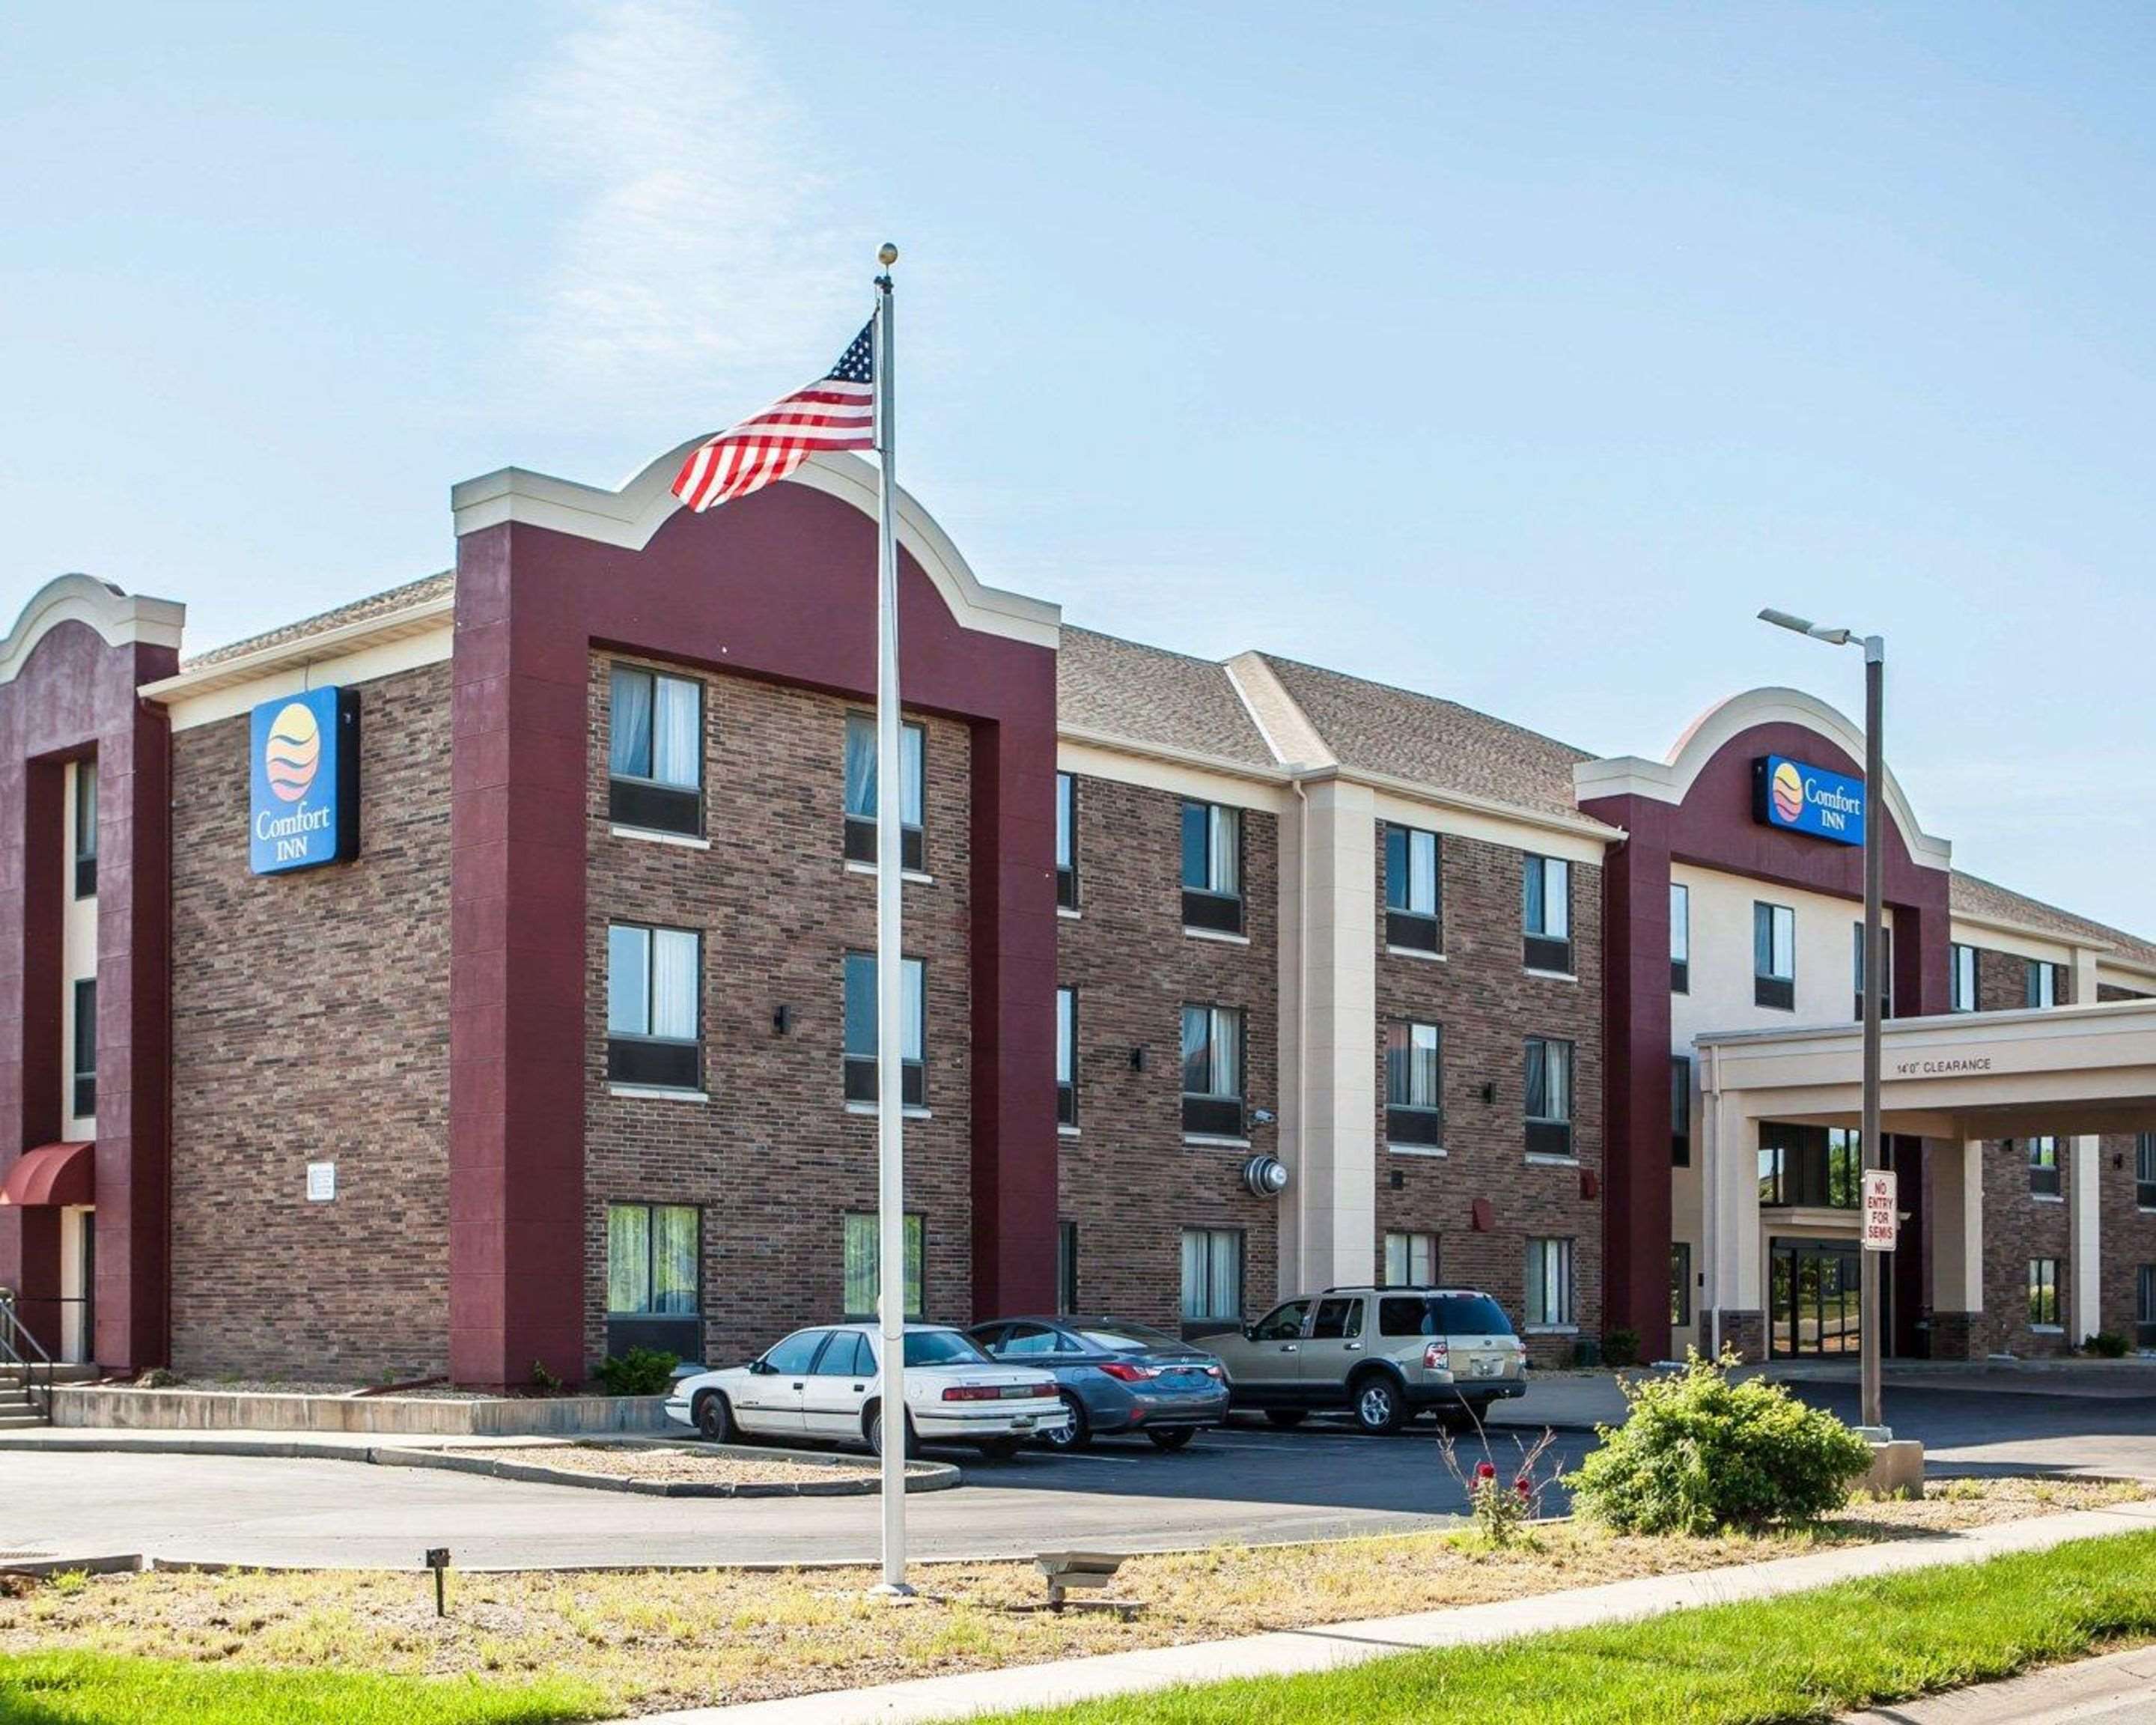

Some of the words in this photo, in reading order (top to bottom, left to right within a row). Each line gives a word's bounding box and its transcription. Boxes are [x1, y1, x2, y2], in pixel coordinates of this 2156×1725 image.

[1805, 777, 1861, 815] Comfort
[256, 800, 330, 840] Comfort
[1821, 809, 1845, 830] INN
[277, 836, 308, 862] INN
[1923, 1058, 1991, 1073] CLEARANCE
[1875, 1182, 1886, 1195] NO
[1868, 1196, 1892, 1209] ENTRY
[1872, 1211, 1888, 1223] FOR
[1868, 1226, 1892, 1239] SEMIS
